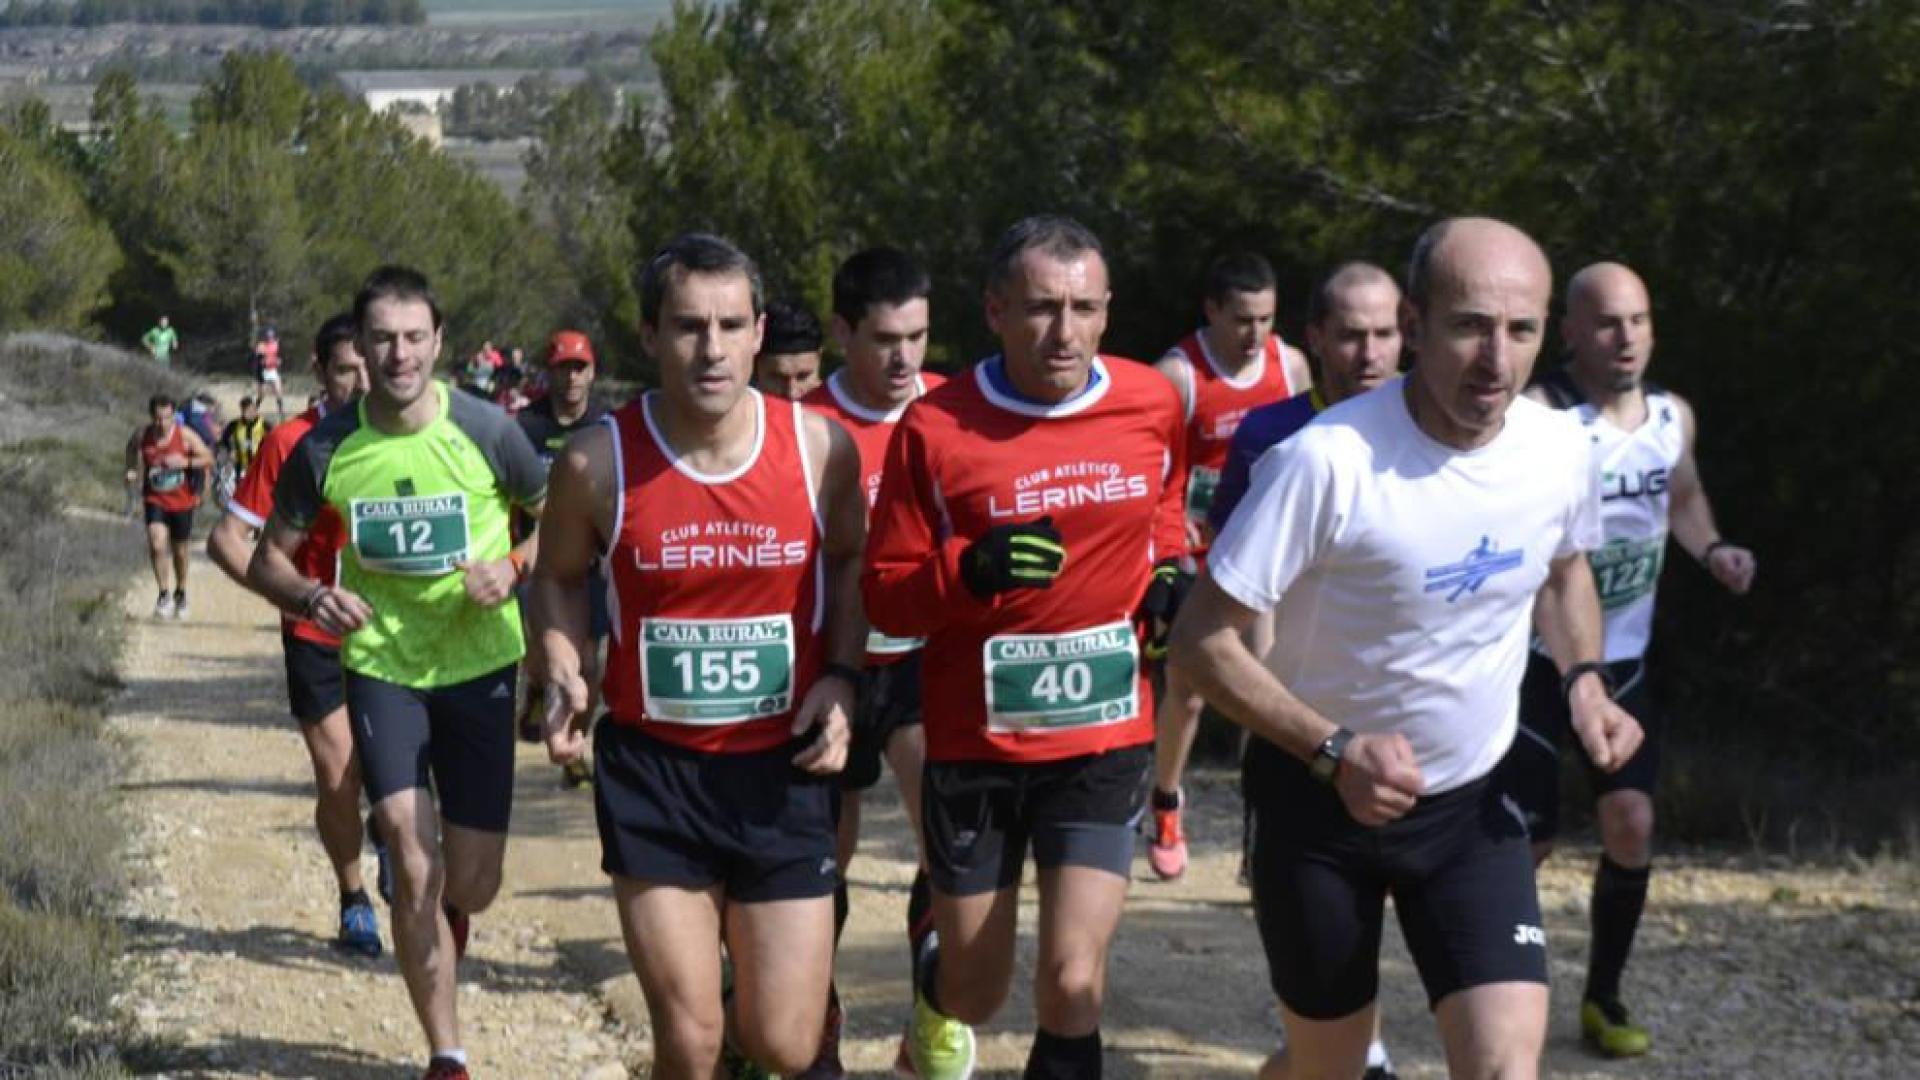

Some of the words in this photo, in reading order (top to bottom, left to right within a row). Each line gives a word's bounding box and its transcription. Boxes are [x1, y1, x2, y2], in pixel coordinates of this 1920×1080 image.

[988, 473, 1148, 519] LERINÉS
[1014, 468, 1050, 491] CLUB
[388, 519, 435, 554] 12
[661, 522, 700, 544] CLUB
[634, 539, 807, 570] LERINÉS
[1600, 557, 1652, 595] 122
[653, 624, 704, 643] CAJA
[708, 622, 780, 641] RURAL
[1000, 641, 1050, 659] CAJA
[1055, 631, 1124, 655] RURAL
[672, 649, 761, 694] 155
[1031, 662, 1093, 704] 40
